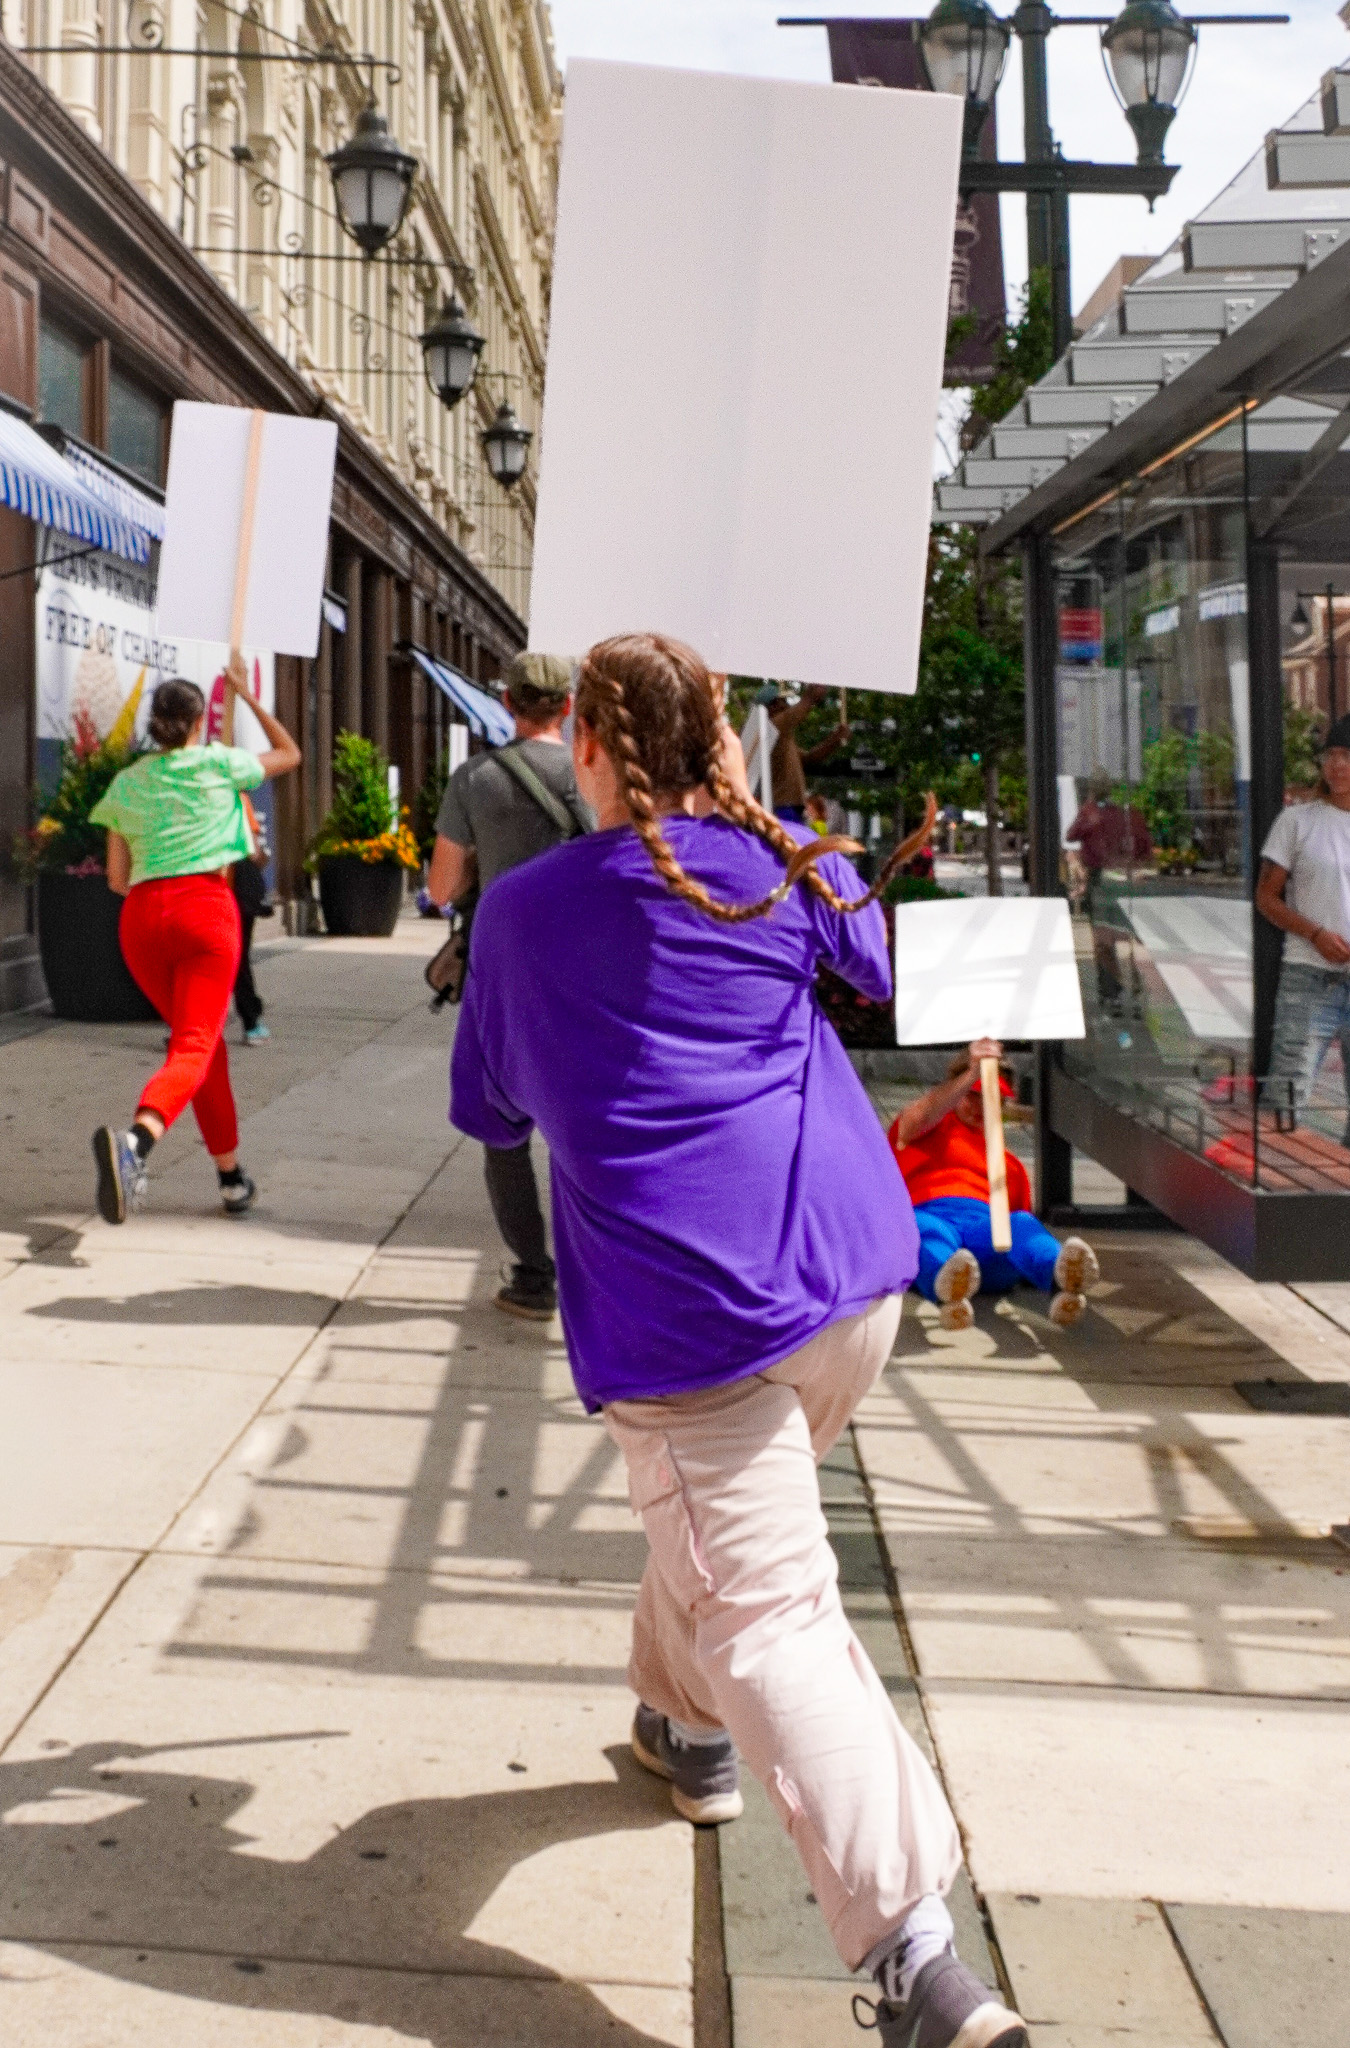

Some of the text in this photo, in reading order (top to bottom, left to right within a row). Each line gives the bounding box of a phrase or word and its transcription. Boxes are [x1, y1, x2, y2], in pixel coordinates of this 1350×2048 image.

[46, 606, 177, 673] FREE OF CHARGE
